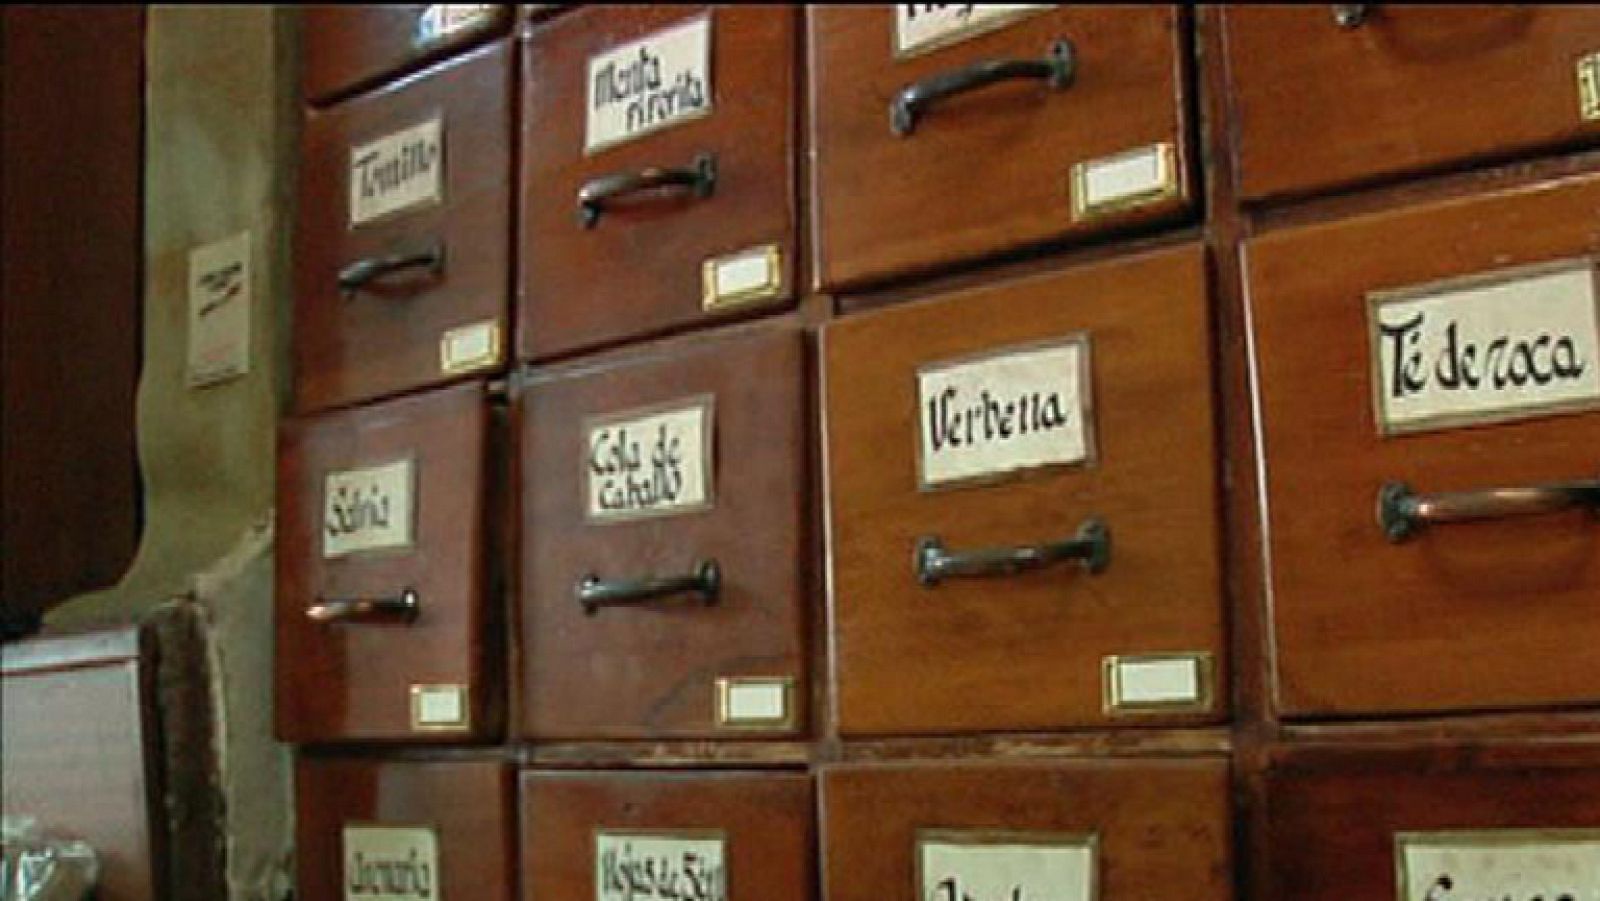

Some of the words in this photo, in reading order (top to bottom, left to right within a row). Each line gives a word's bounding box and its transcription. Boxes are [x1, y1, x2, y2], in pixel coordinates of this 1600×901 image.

[1380, 311, 1426, 397] Té
[1435, 319, 1480, 390] de
[1487, 331, 1583, 390] roca
[590, 429, 641, 475] Cola
[652, 424, 681, 469] de
[326, 486, 389, 537] Salvia
